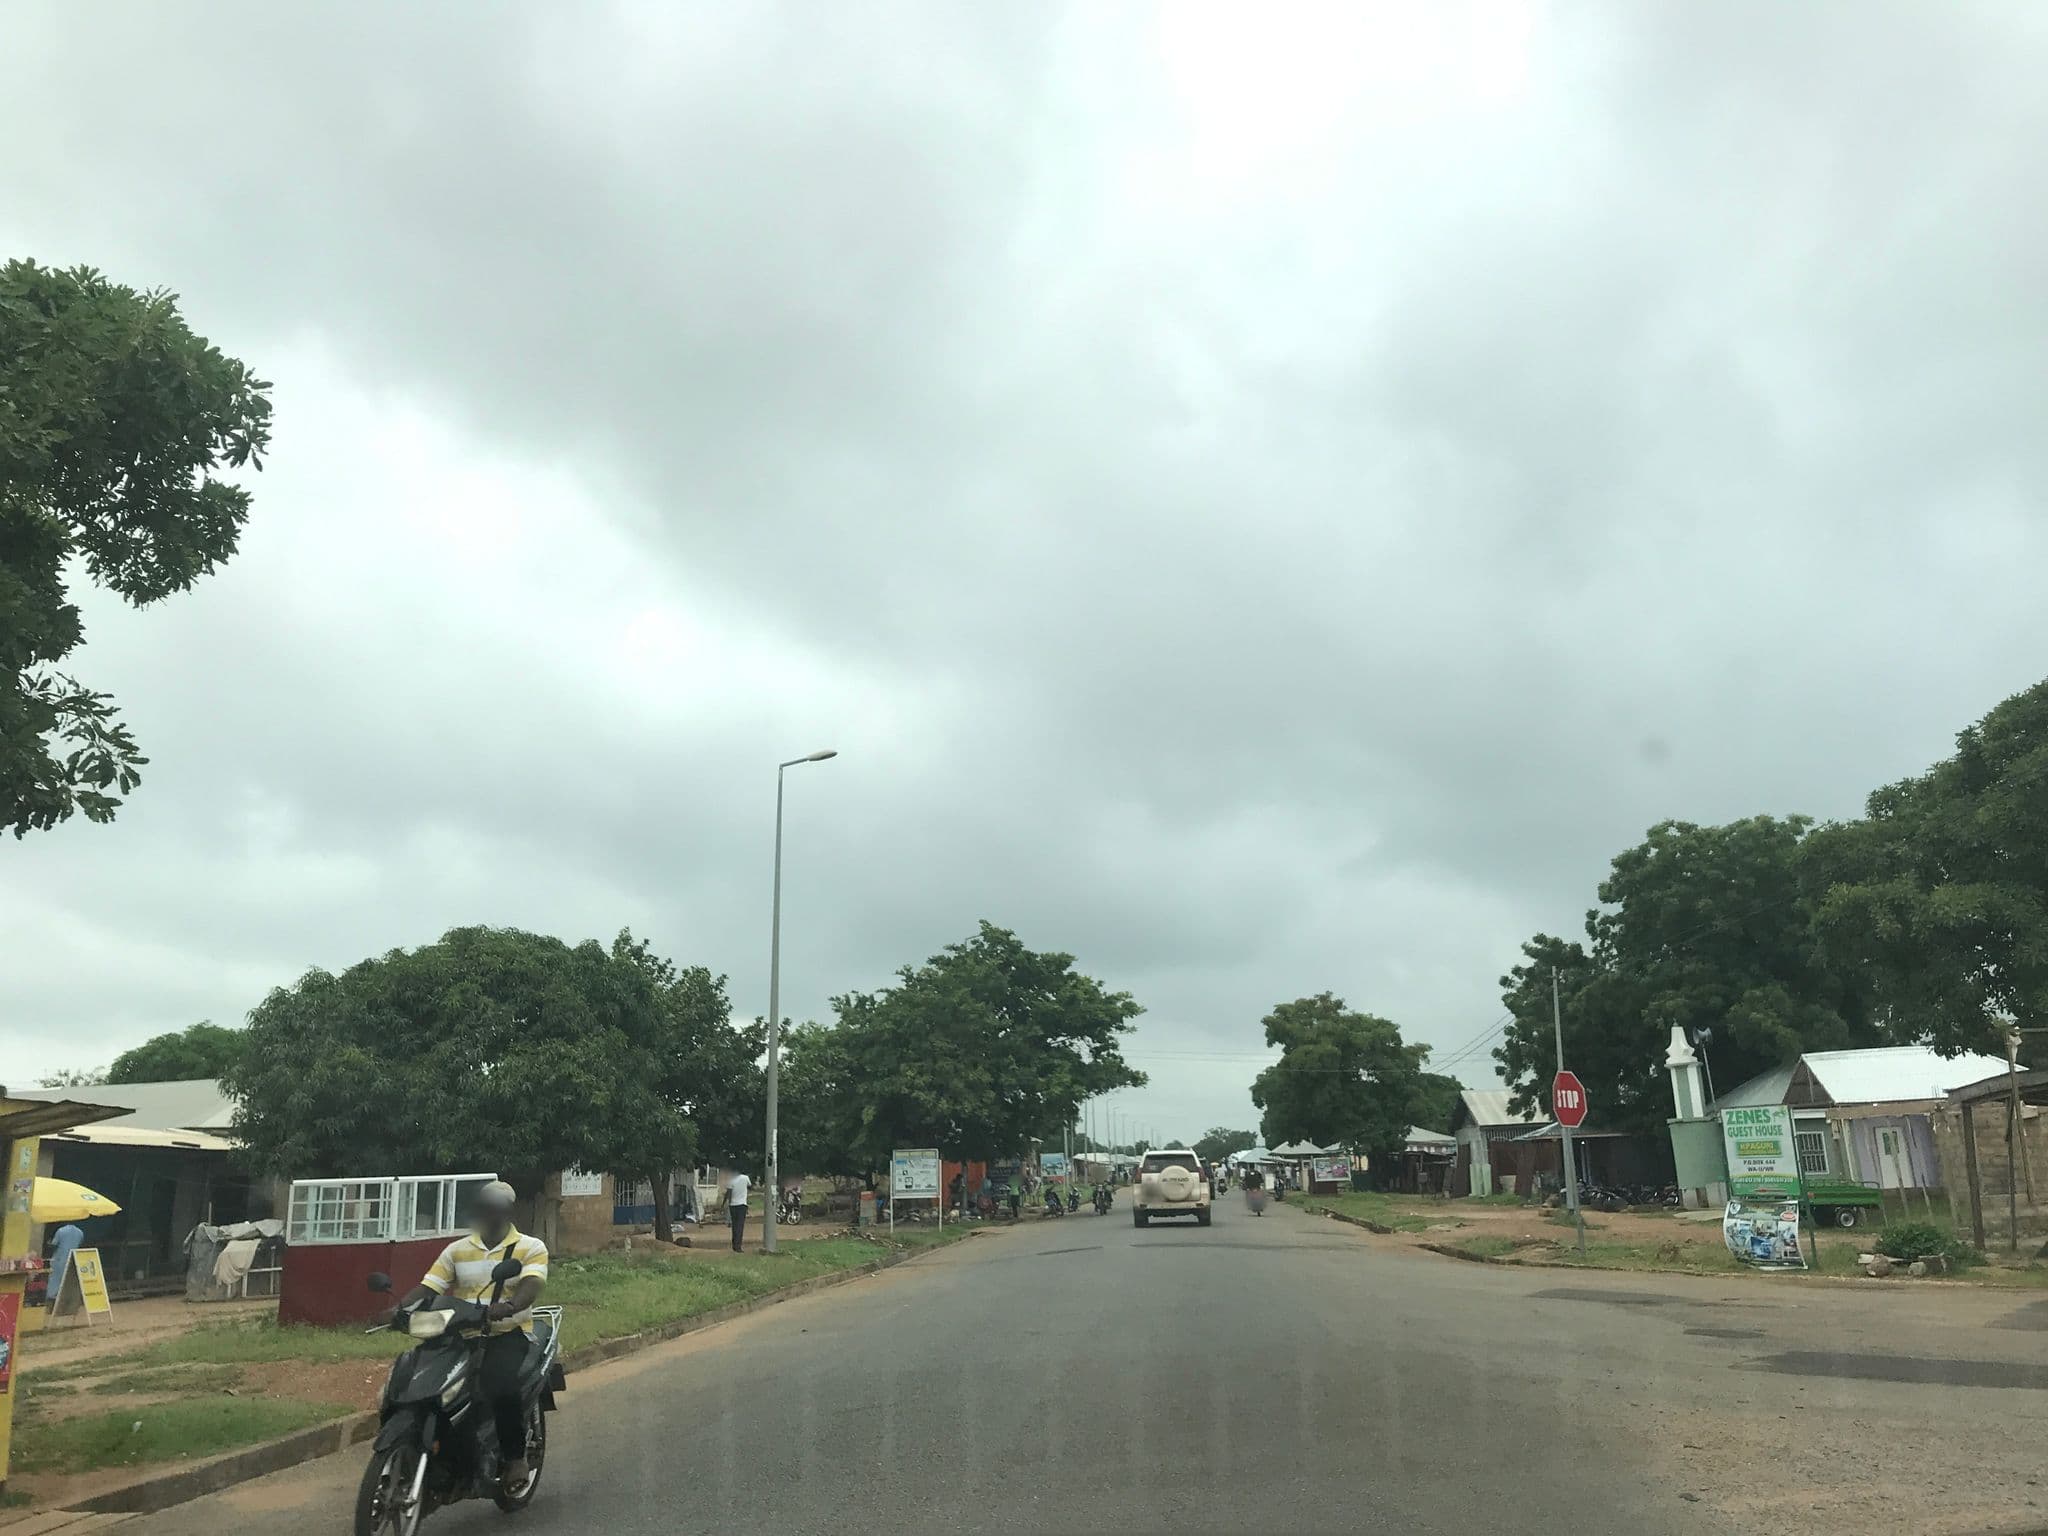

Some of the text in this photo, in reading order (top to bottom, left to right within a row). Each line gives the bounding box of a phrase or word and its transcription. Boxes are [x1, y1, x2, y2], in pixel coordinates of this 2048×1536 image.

[1556, 1089, 1579, 1109] STOP
[1726, 1109, 1771, 1125] ZENES
[1727, 1125, 1783, 1138] GUEST HOUSE
